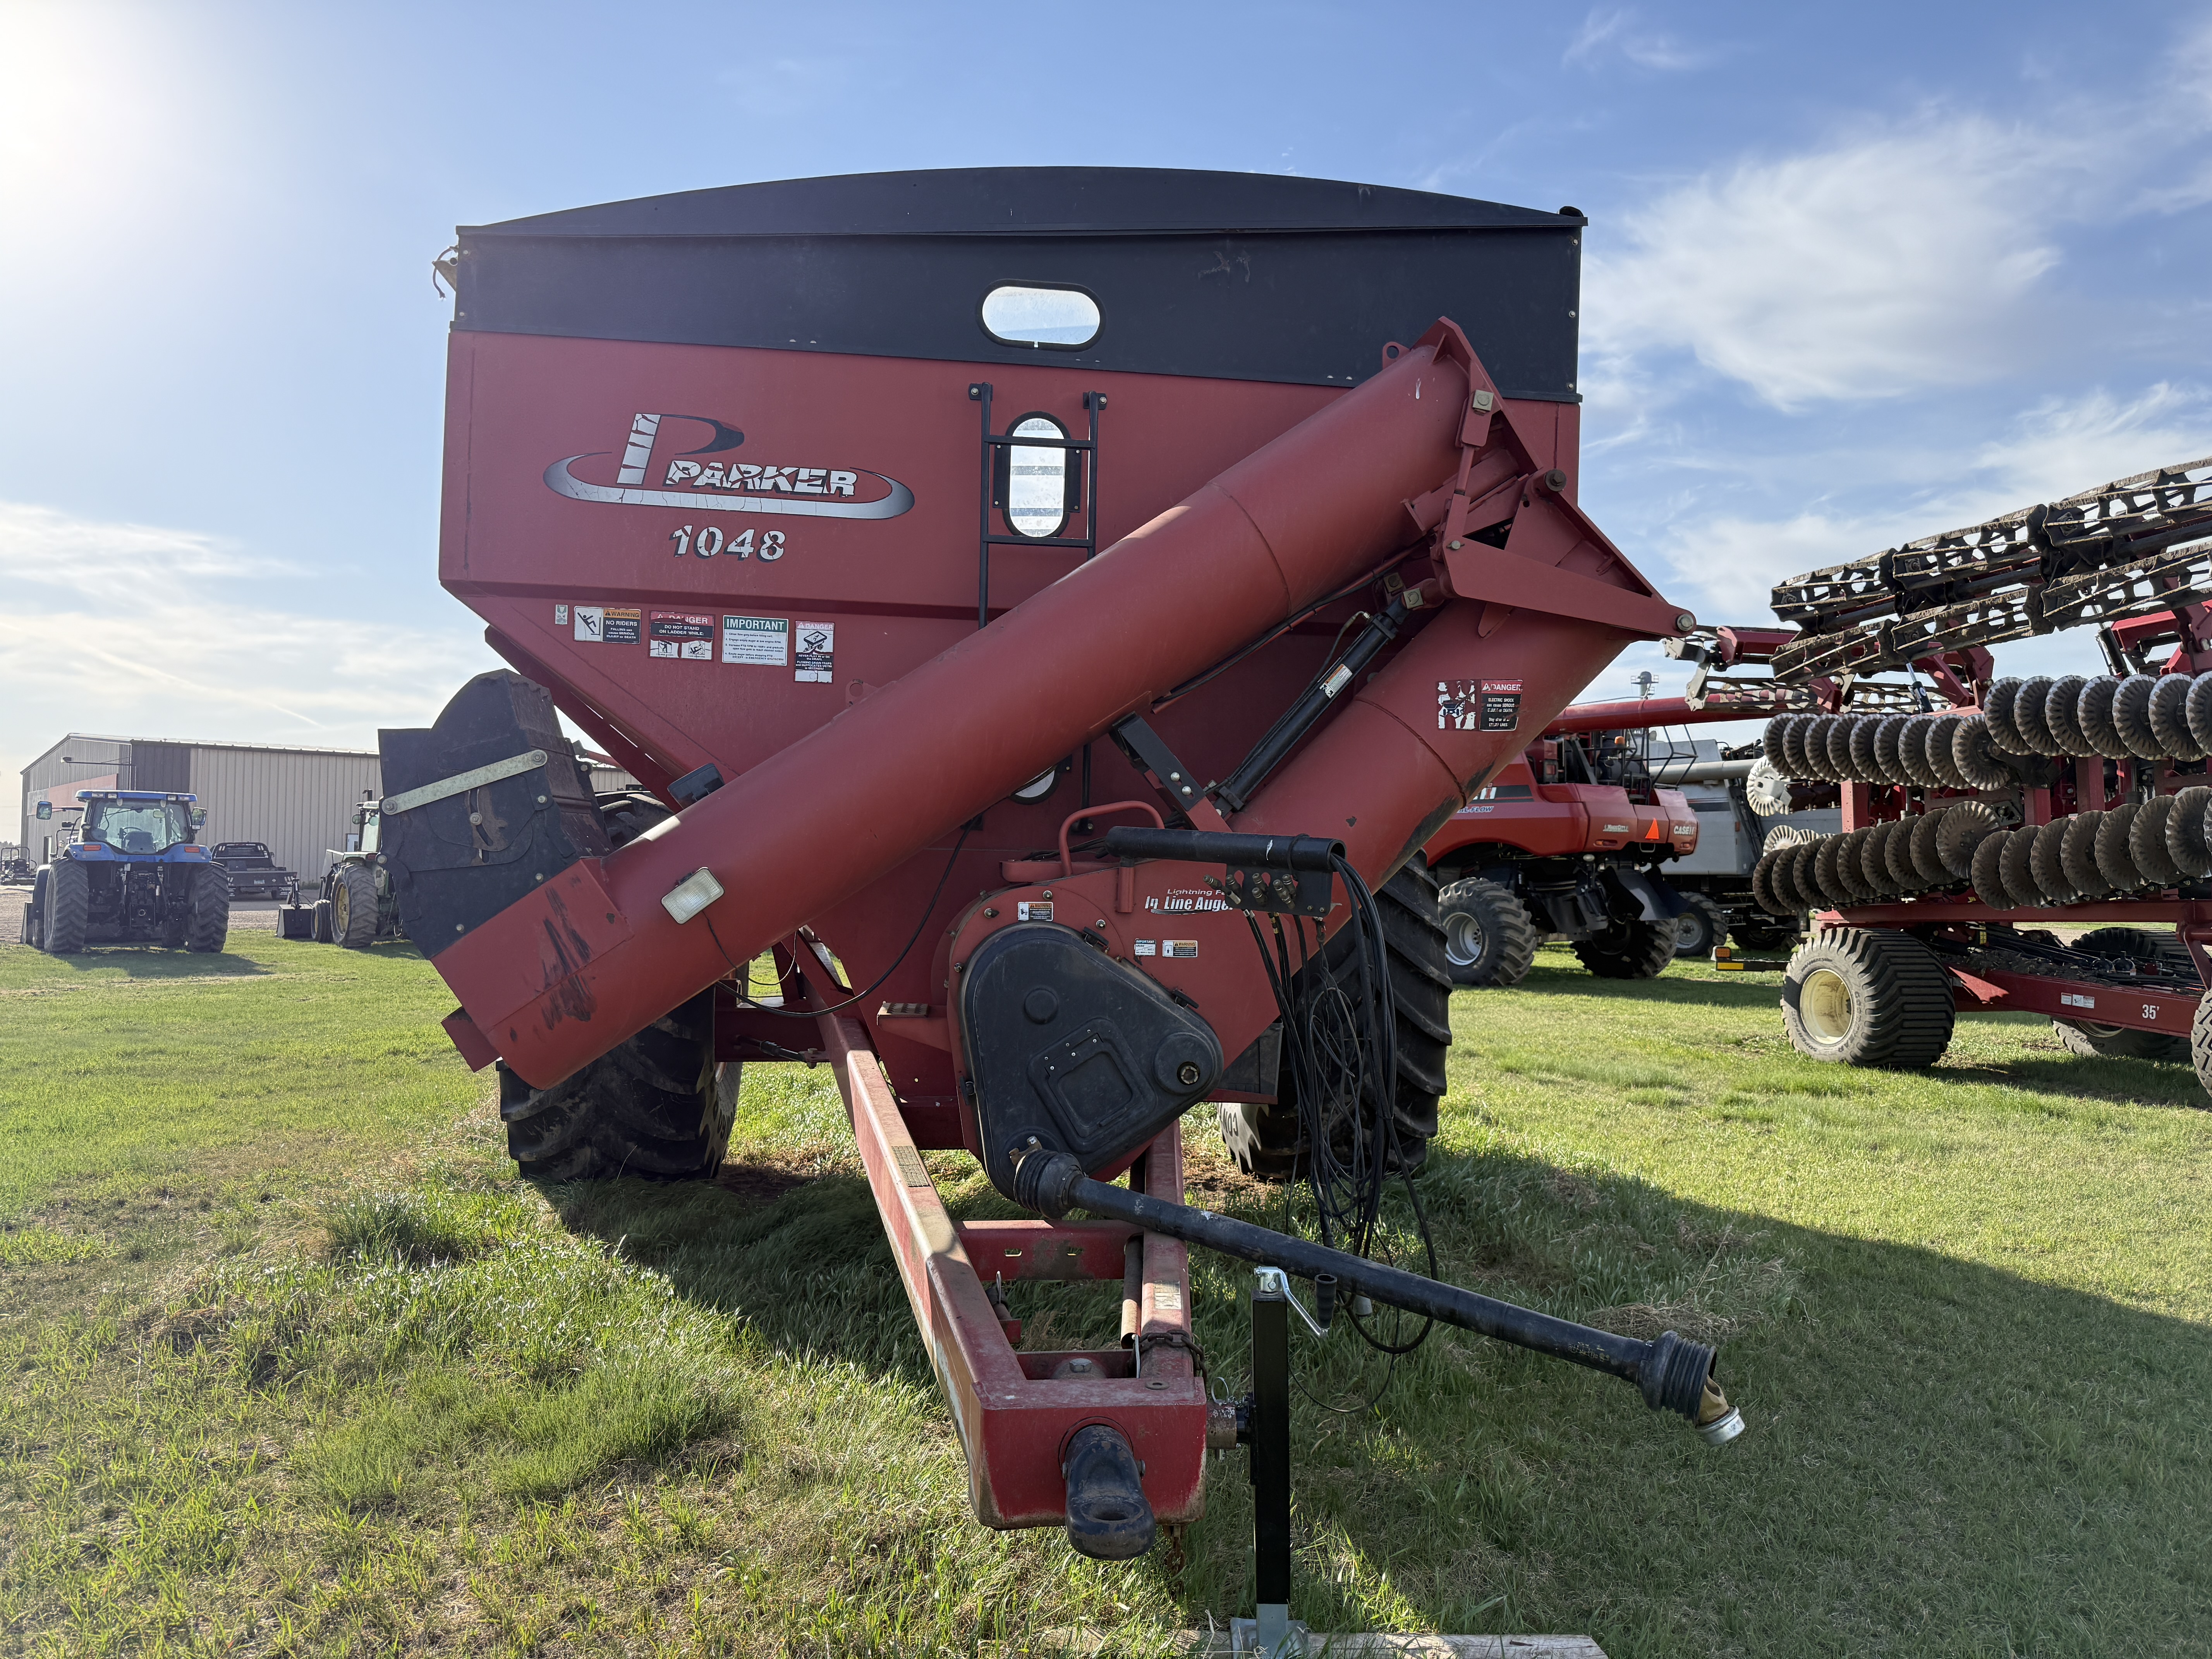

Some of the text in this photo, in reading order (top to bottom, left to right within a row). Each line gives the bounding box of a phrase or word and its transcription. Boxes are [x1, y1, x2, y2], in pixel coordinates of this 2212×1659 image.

[664, 460, 857, 497] PARKER
[671, 525, 785, 562] 1048
[726, 618, 784, 631] IMPORTANT
[1145, 896, 1233, 912] In Line Auge
[2142, 1004, 2160, 1019] 35'
